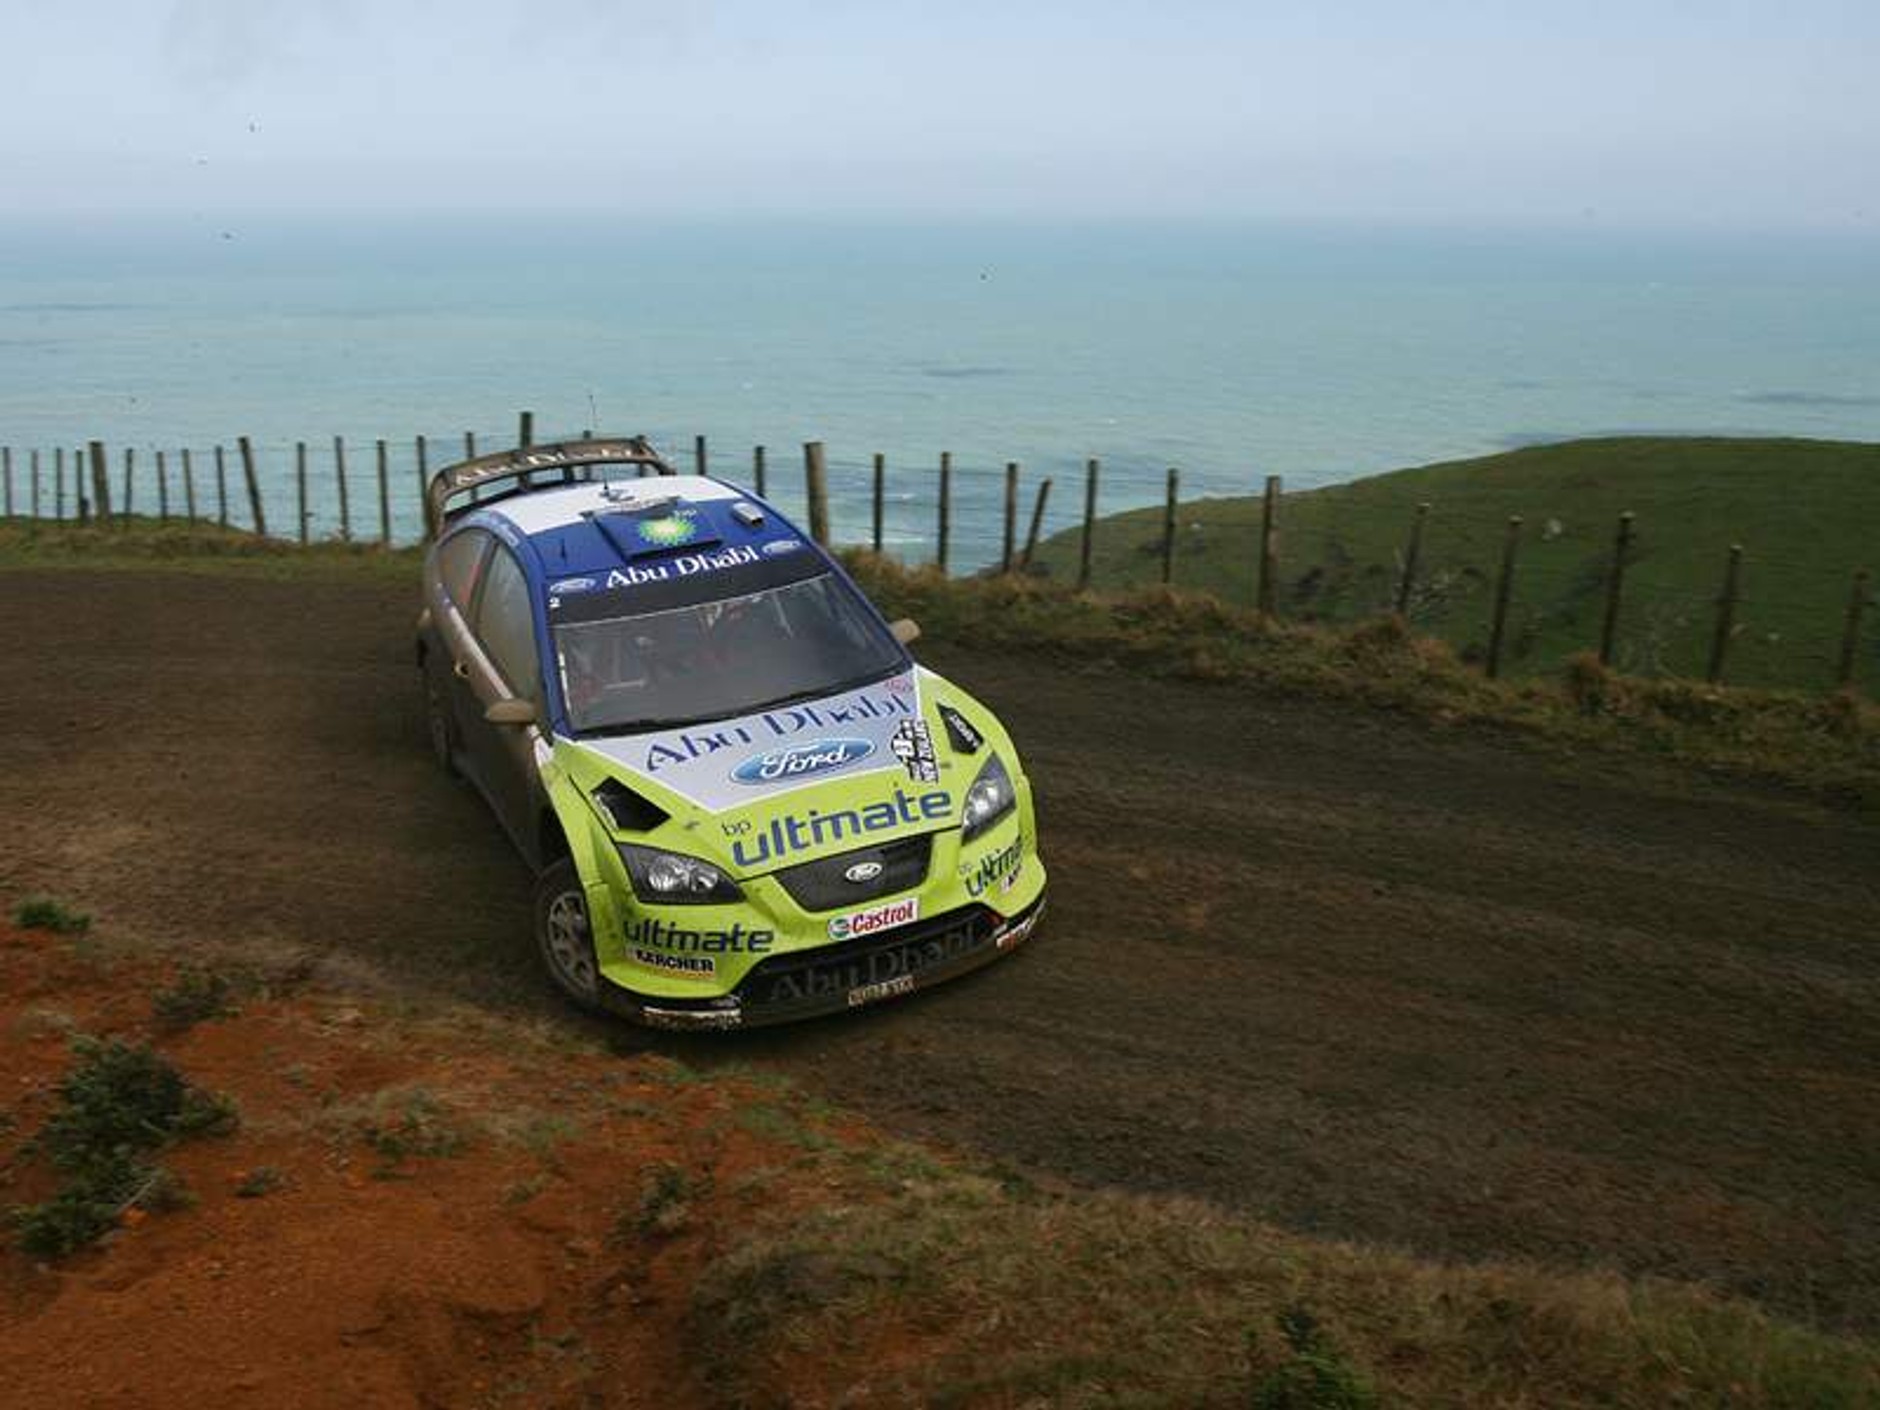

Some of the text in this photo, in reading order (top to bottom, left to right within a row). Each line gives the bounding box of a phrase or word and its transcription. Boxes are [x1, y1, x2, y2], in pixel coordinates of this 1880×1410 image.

[606, 569, 669, 589] Abu
[675, 545, 760, 575] Dhabi
[646, 729, 752, 771] Abu
[763, 693, 911, 736] Dhabi
[760, 742, 852, 778] Ford
[722, 789, 953, 866] bp ultimate
[624, 919, 774, 953] ultimate
[852, 902, 914, 934] Castrol
[771, 961, 859, 1000] Abu
